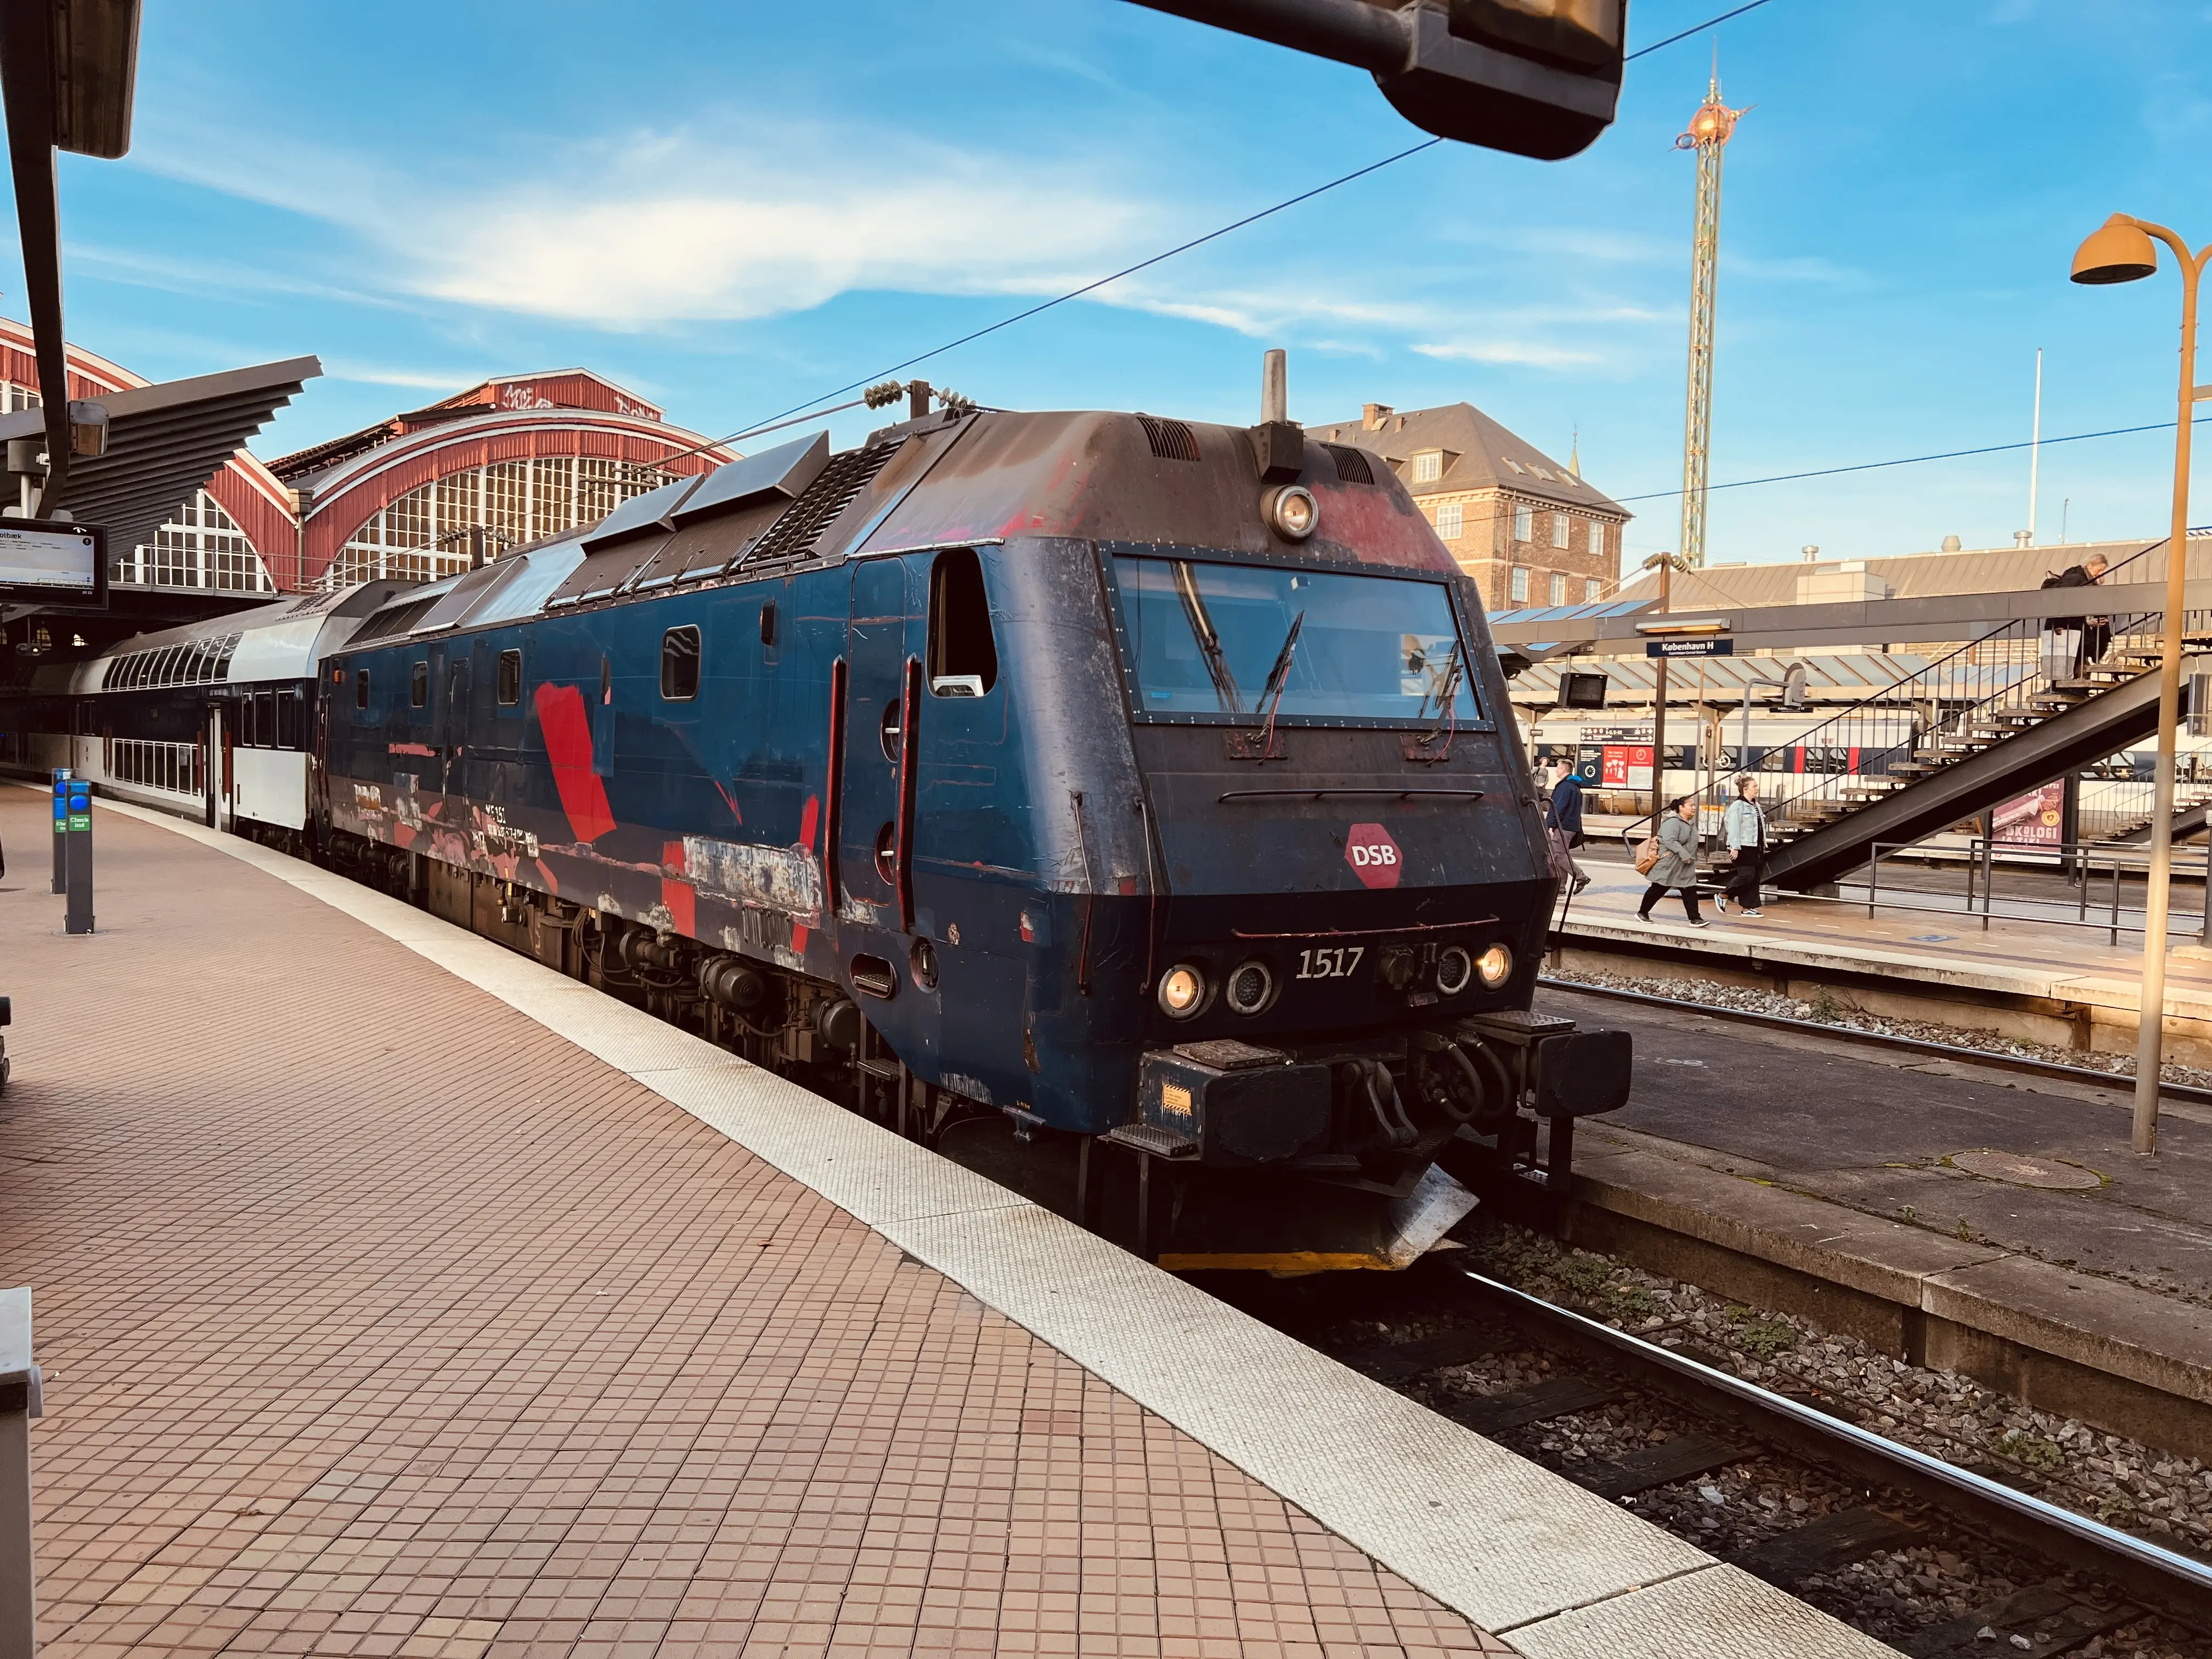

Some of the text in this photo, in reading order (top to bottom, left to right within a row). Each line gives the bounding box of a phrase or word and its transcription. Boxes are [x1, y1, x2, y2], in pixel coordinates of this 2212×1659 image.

[1662, 641, 1714, 651] København H
[1351, 844, 1396, 866] DSB
[1296, 947, 1364, 979] 1517
